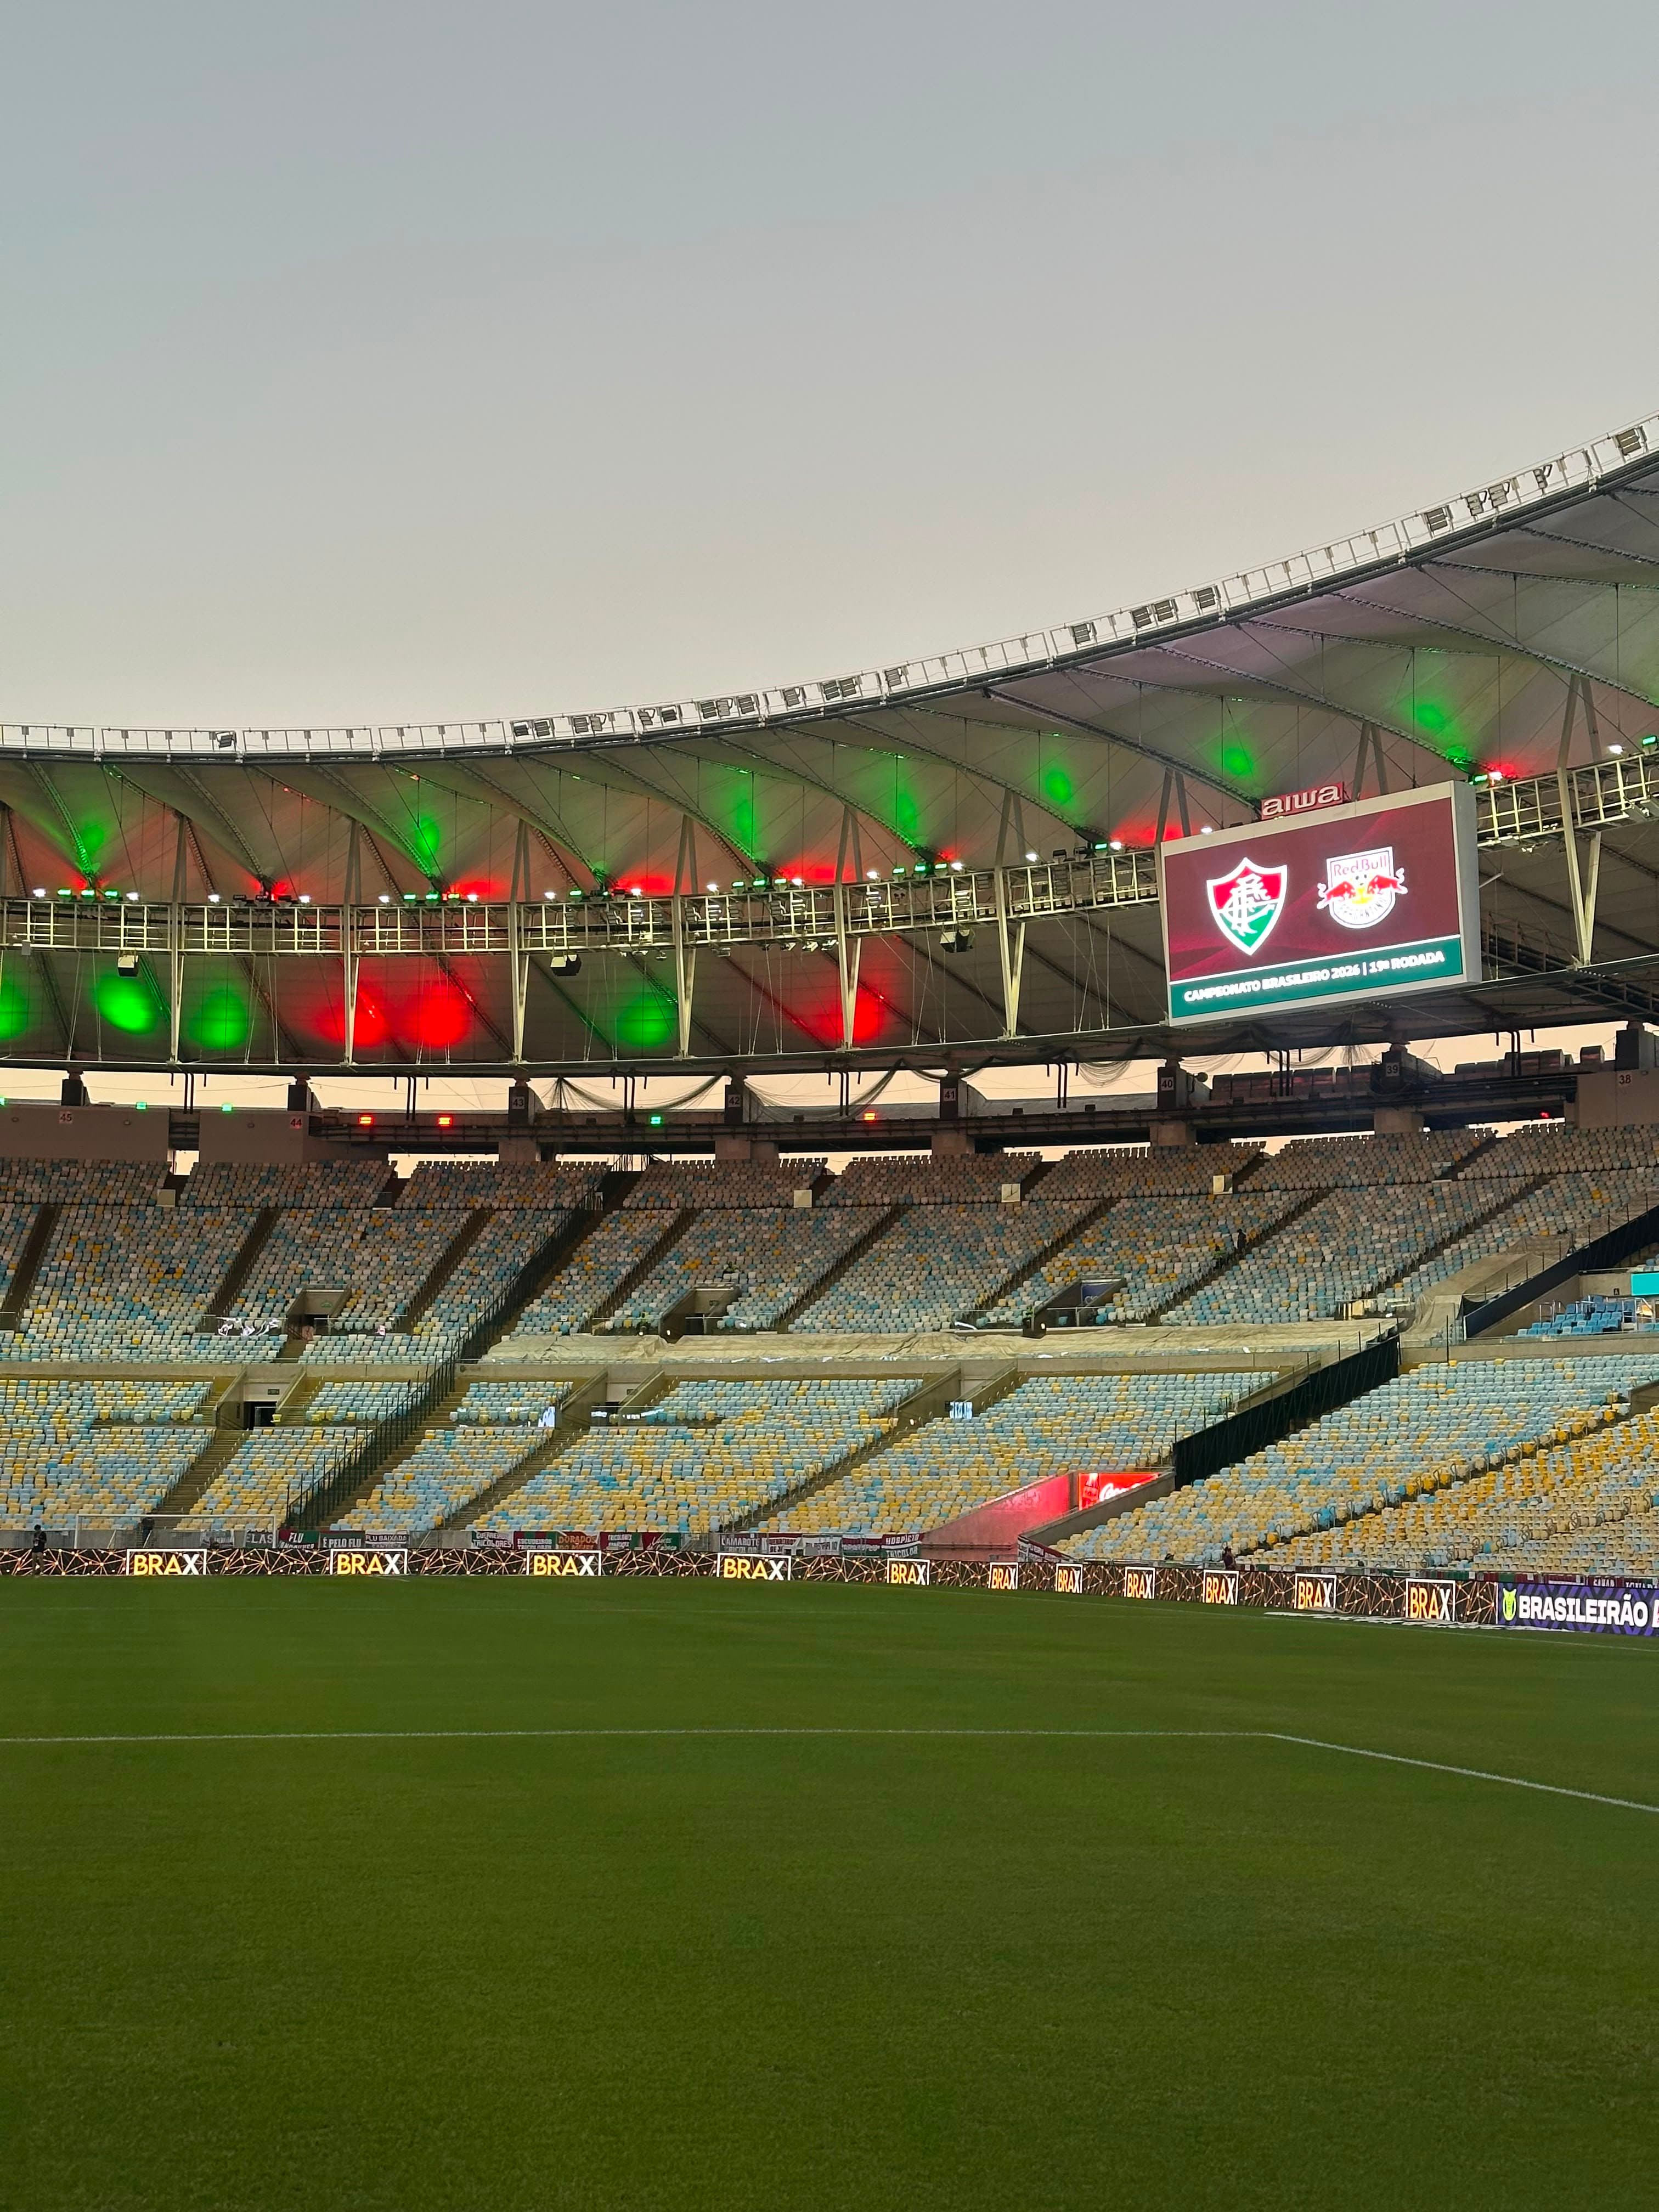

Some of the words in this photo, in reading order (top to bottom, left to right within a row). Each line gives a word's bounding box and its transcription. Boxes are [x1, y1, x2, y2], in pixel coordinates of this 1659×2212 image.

[1262, 785, 1340, 816] aiwa
[1334, 860, 1358, 877] Red
[1361, 854, 1386, 871] Bull
[1183, 980, 1261, 1002] CAMPEONATO
[1261, 968, 1330, 990] BRASILEIRO
[1331, 963, 1361, 979] 2026
[1391, 950, 1446, 970] RODADA
[1386, 1064, 1398, 1074] 39
[1619, 1074, 1632, 1085] 38
[1161, 1079, 1173, 1088] 40
[513, 1098, 523, 1107] 43
[60, 1113, 72, 1121] 45
[290, 1119, 302, 1127] 44
[289, 1532, 304, 1543] FLU
[329, 1538, 347, 1548] PELO
[348, 1537, 362, 1548] FLU
[133, 1554, 200, 1575] BRAX
[337, 1553, 400, 1575] BRAX
[533, 1555, 595, 1576] BRAX
[723, 1558, 785, 1581] BRAX
[890, 1564, 927, 1585] BRAX
[991, 1567, 1016, 1590] BRAX
[1057, 1569, 1080, 1594] BRAX
[1127, 1572, 1153, 1599] BRAX
[1205, 1576, 1235, 1605] BRAX
[1297, 1581, 1333, 1610] BRAX
[1410, 1587, 1451, 1621] BRAX
[1518, 1593, 1649, 1628] BRASILEIRÃO
